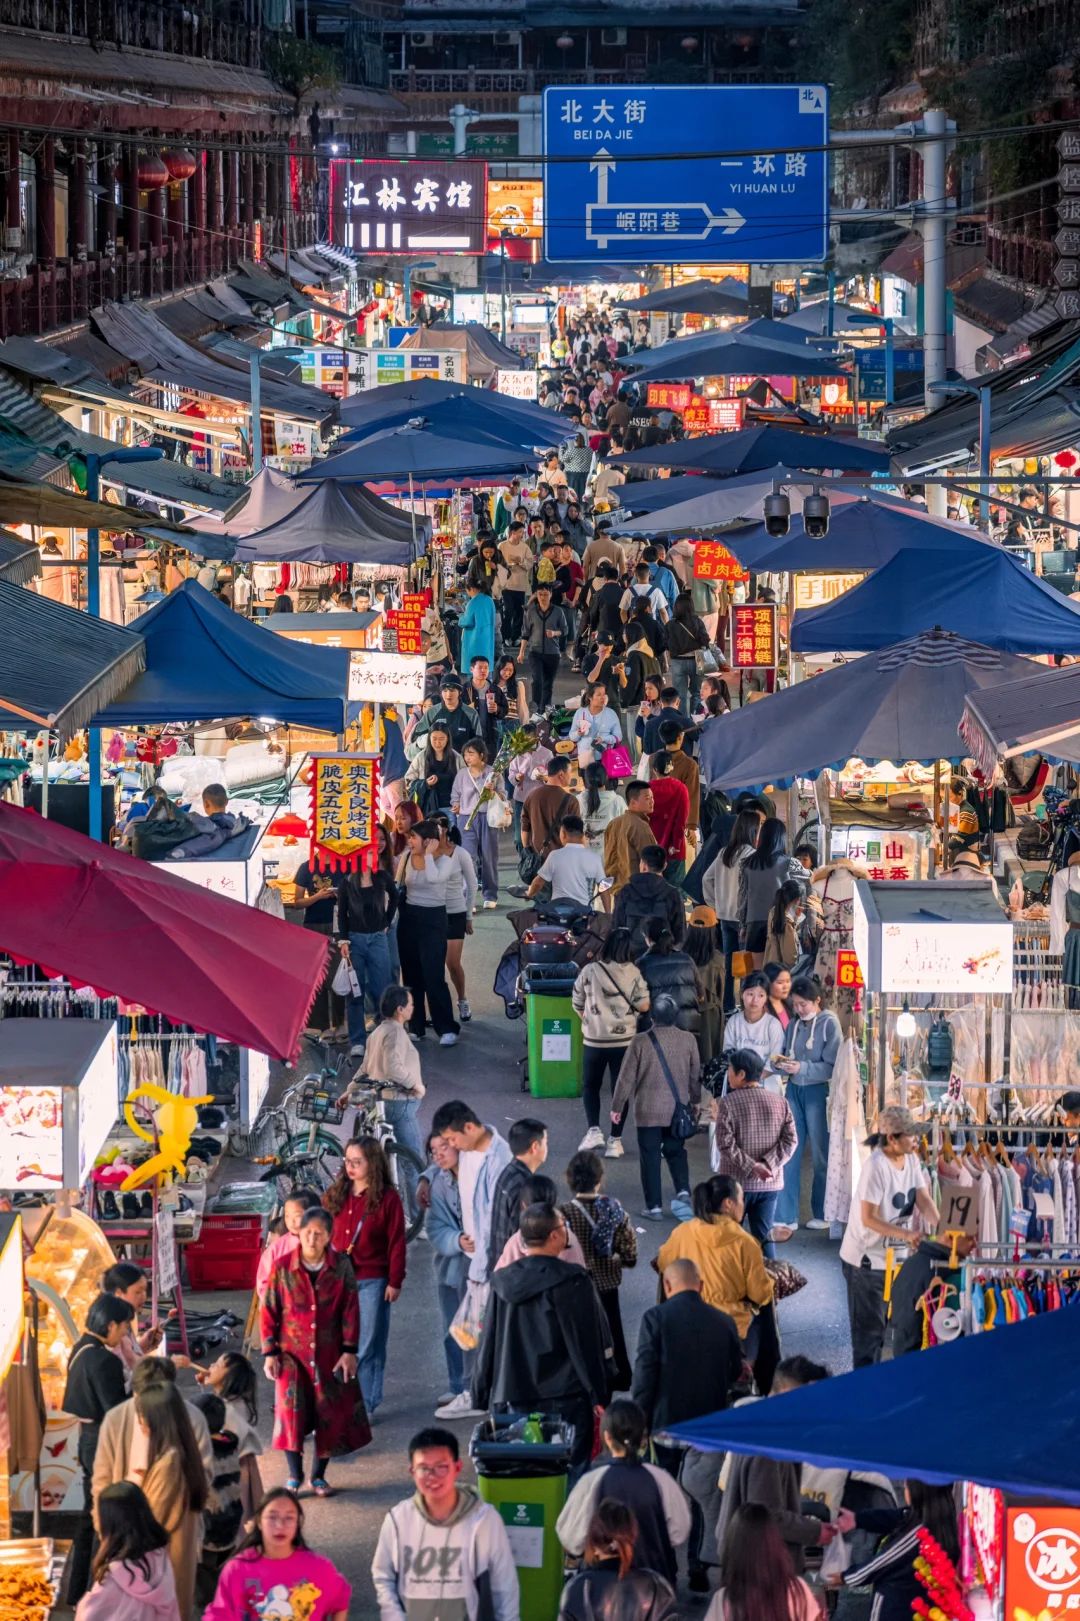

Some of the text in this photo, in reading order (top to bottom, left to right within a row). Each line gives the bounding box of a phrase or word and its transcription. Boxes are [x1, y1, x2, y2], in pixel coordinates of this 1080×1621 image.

[802, 89, 814, 101] 北
[561, 99, 646, 123] 北大街
[574, 129, 633, 140] BEI DA JIE
[720, 152, 807, 177] 一环路
[343, 178, 473, 212] 汇林宾馆
[730, 183, 796, 193] YI HUAN LU
[616, 212, 681, 232] 岷阳巷
[354, 354, 366, 396] 手机维
[444, 356, 455, 386] 名表
[649, 389, 688, 406] 印度飞饼
[698, 562, 747, 577] 卤肉卷
[399, 638, 416, 650] 50
[736, 610, 753, 663] 手工编串
[754, 610, 772, 663] 项链脚链
[319, 765, 343, 840] 脆皮五花肉
[346, 765, 370, 840] 奥尔良烤翅
[947, 1196, 972, 1226] 19
[1036, 1538, 1078, 1580] 冰
